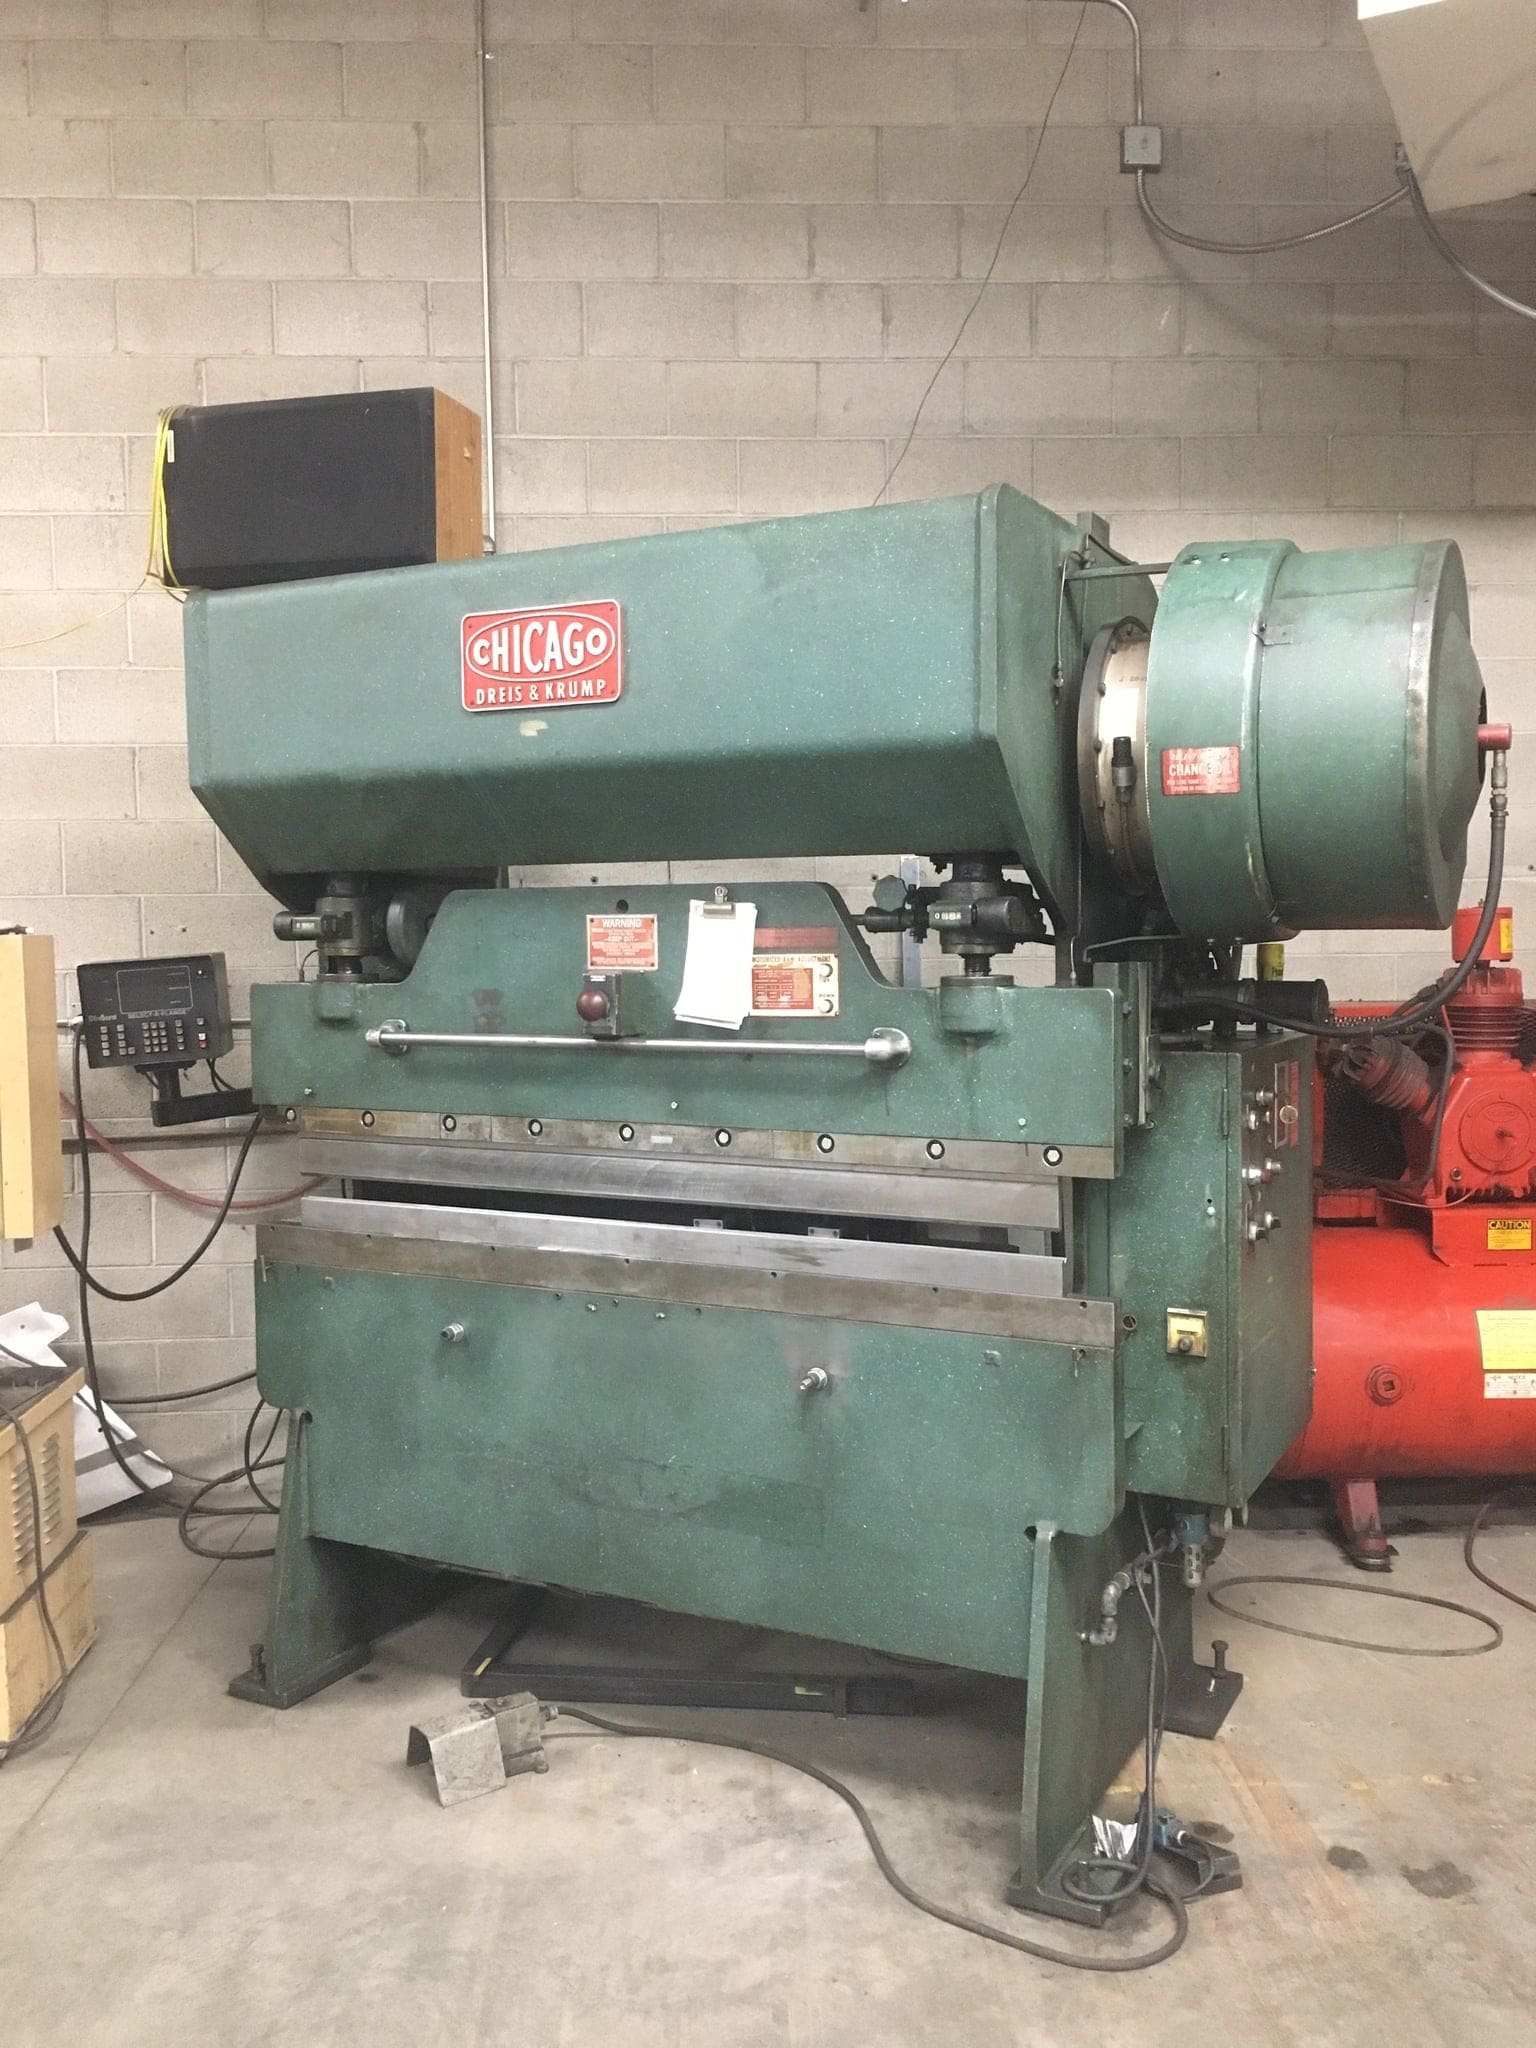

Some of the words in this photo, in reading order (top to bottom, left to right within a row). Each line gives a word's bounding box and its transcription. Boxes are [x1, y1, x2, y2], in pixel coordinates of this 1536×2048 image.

[473, 620, 608, 673] CHICAGO
[476, 686, 522, 705] DREIS
[529, 685, 540, 701] &
[545, 679, 607, 700] KRUMP
[602, 918, 642, 929] WARNING
[1489, 1220, 1530, 1230] CAUTION
